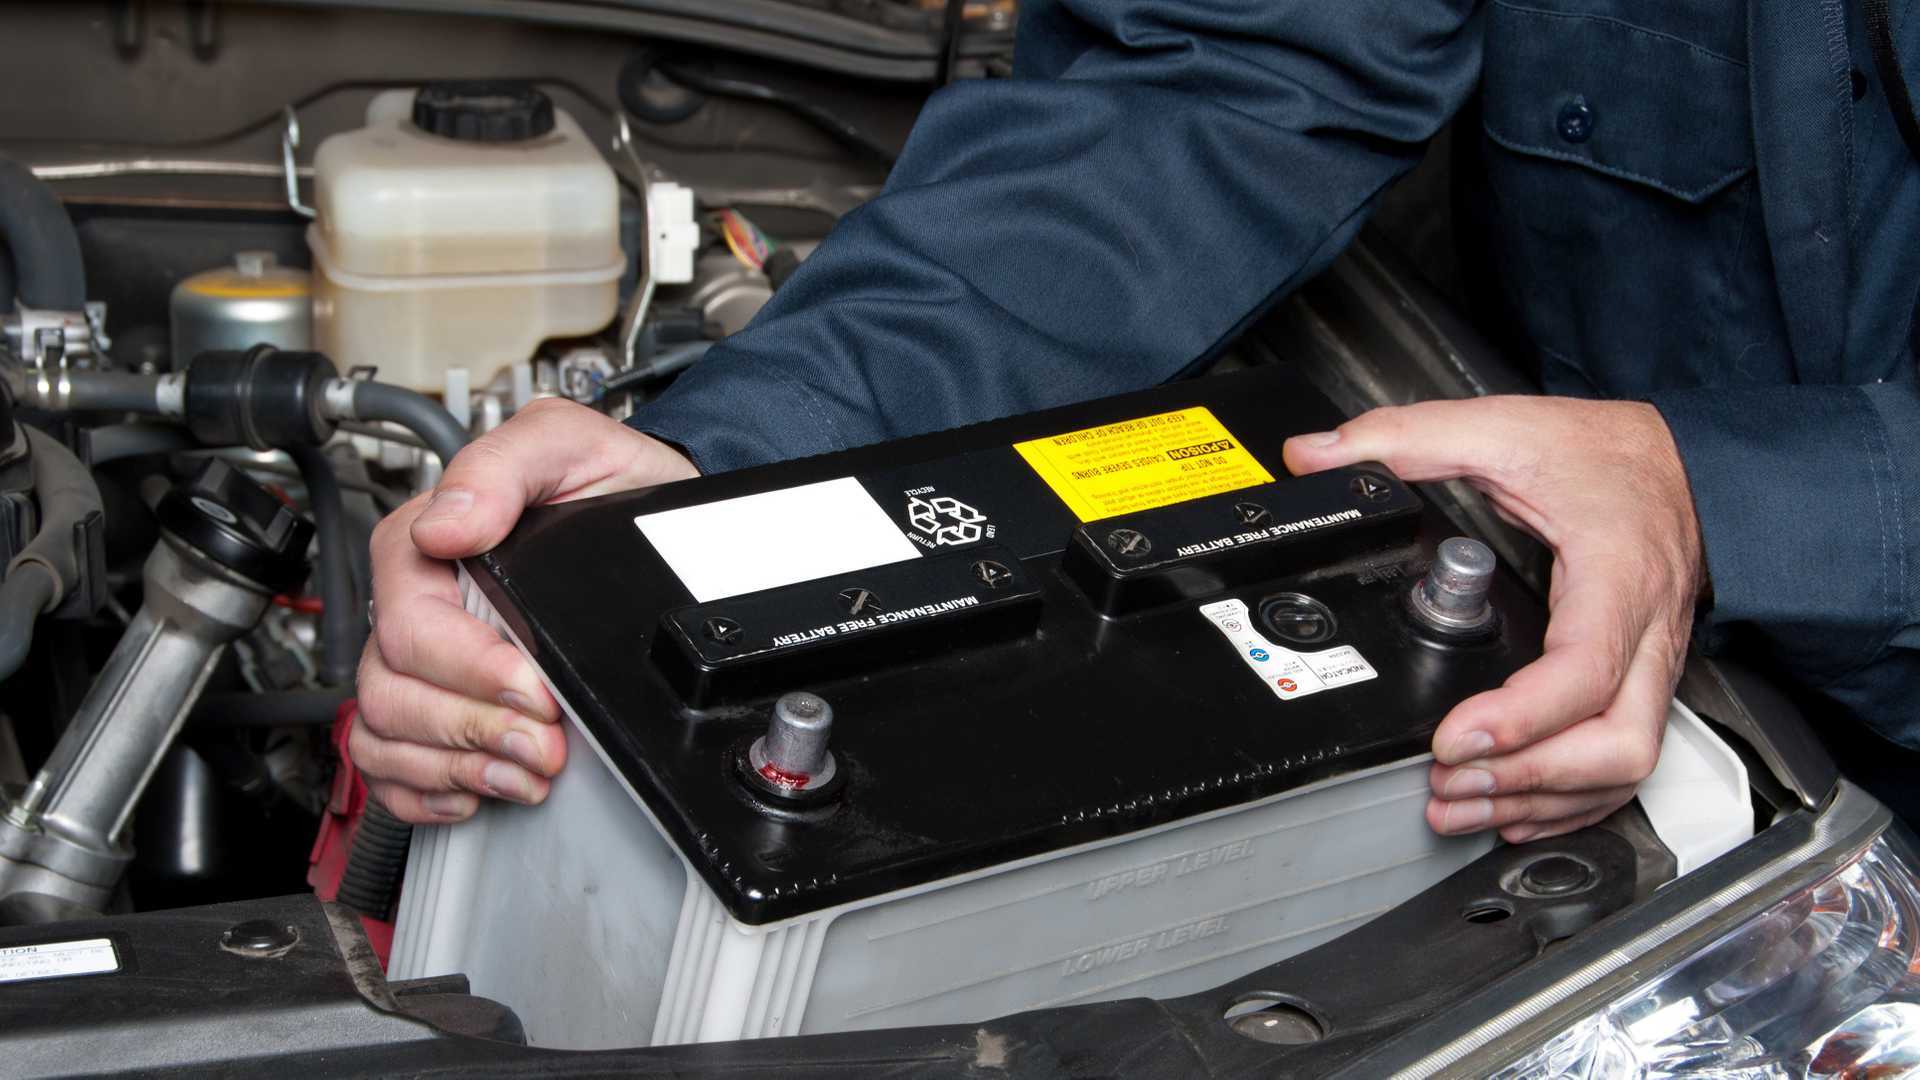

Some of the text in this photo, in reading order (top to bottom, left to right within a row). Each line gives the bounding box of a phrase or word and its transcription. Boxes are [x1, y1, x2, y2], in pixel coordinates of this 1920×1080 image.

[1169, 442, 1221, 459] POISON
[1101, 460, 1131, 474] SEVERE
[1196, 458, 1213, 468] NOT
[904, 486, 935, 496] RECYCLE
[906, 532, 936, 549] RETURN
[1175, 509, 1362, 557] MAINTENANCE FREE BATTERY
[772, 595, 979, 647] MAINTENANCE FREE BATTERY
[1320, 664, 1366, 680] INDICATOR
[1087, 839, 1255, 900] UPPER LEVEL
[1061, 915, 1231, 977] LOWER LEVEL
